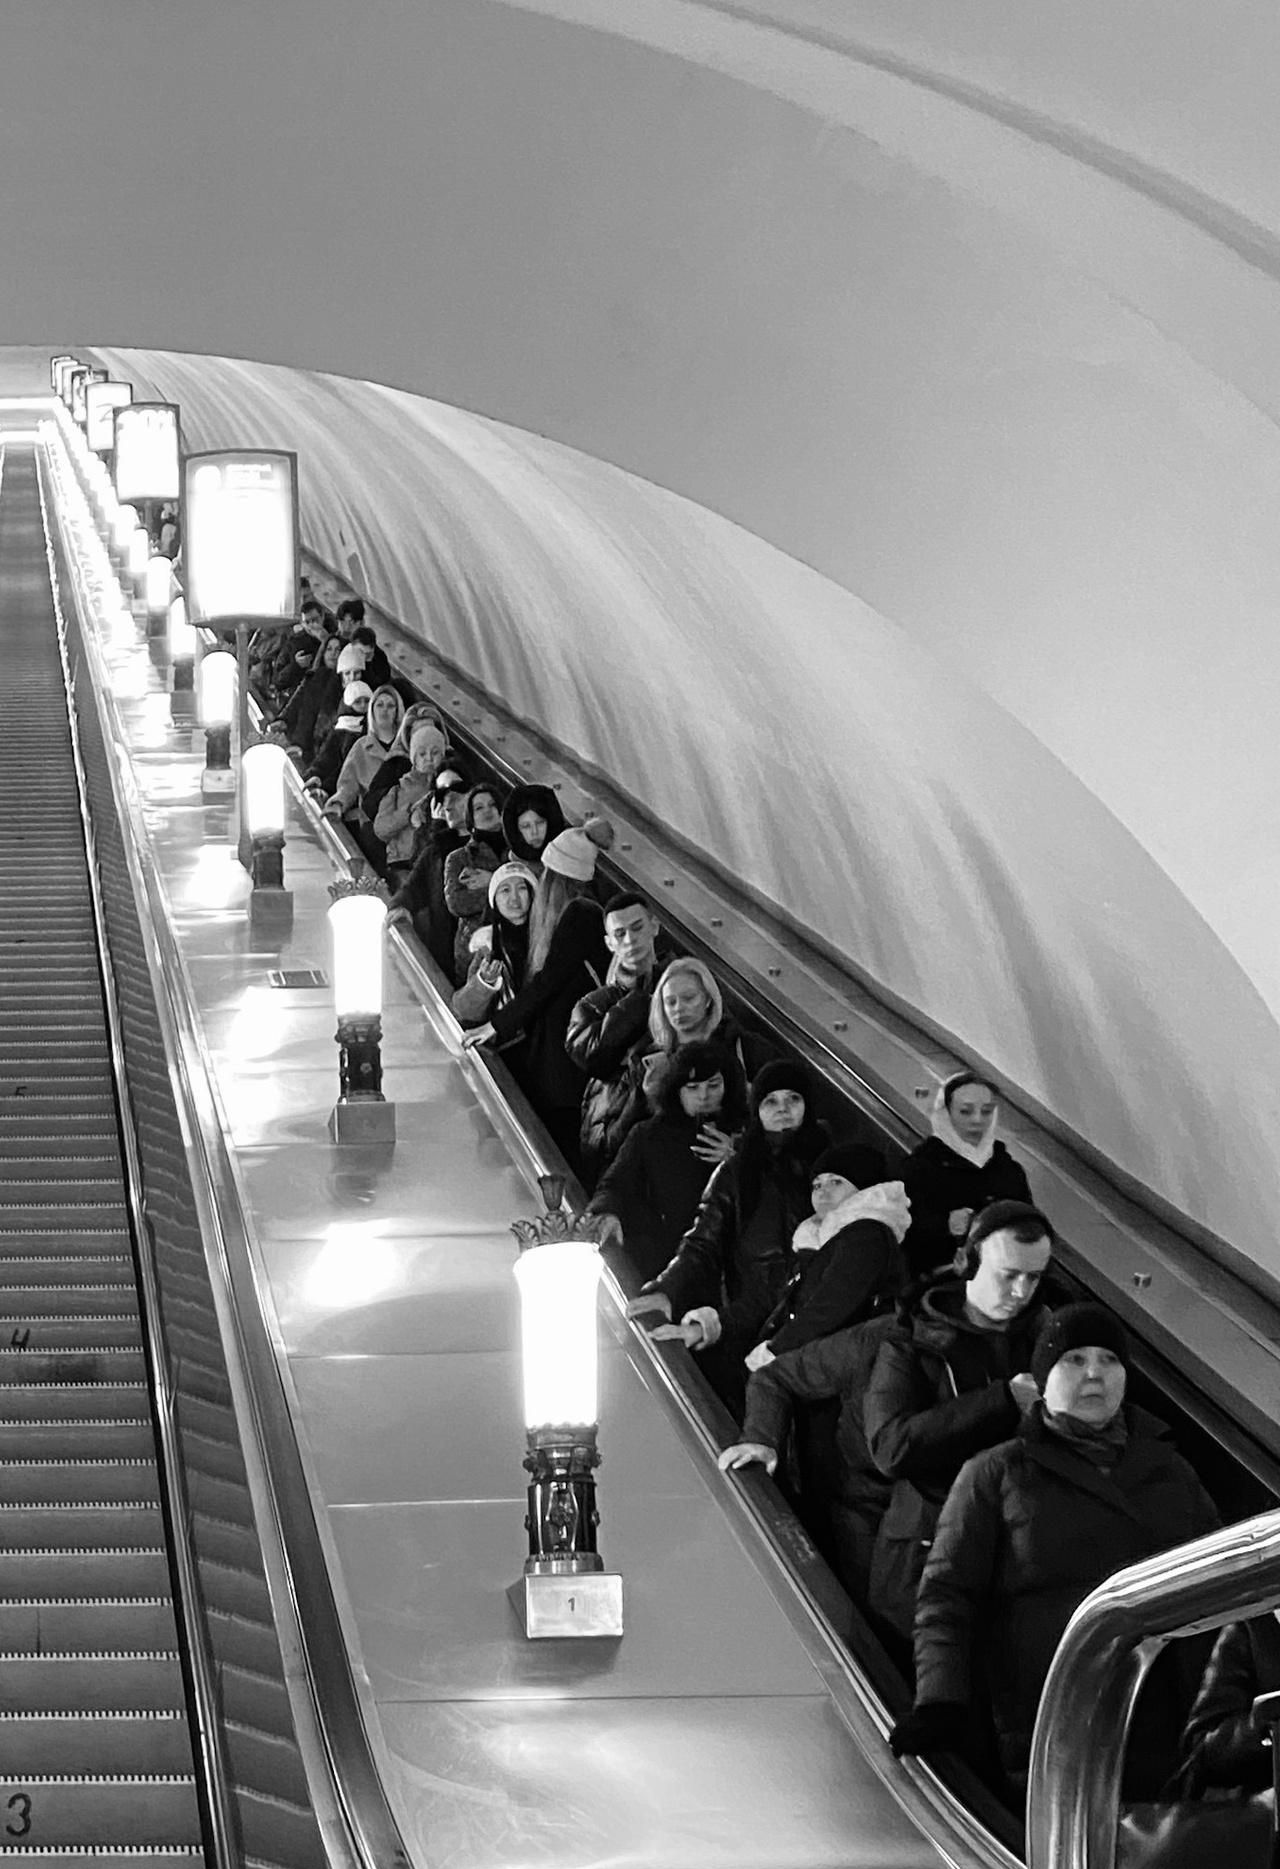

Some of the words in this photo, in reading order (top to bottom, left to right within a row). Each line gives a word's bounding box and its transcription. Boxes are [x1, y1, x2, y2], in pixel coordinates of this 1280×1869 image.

[10, 1328, 31, 1353] 4
[567, 1597, 576, 1612] 1
[5, 1793, 32, 1838] 3
